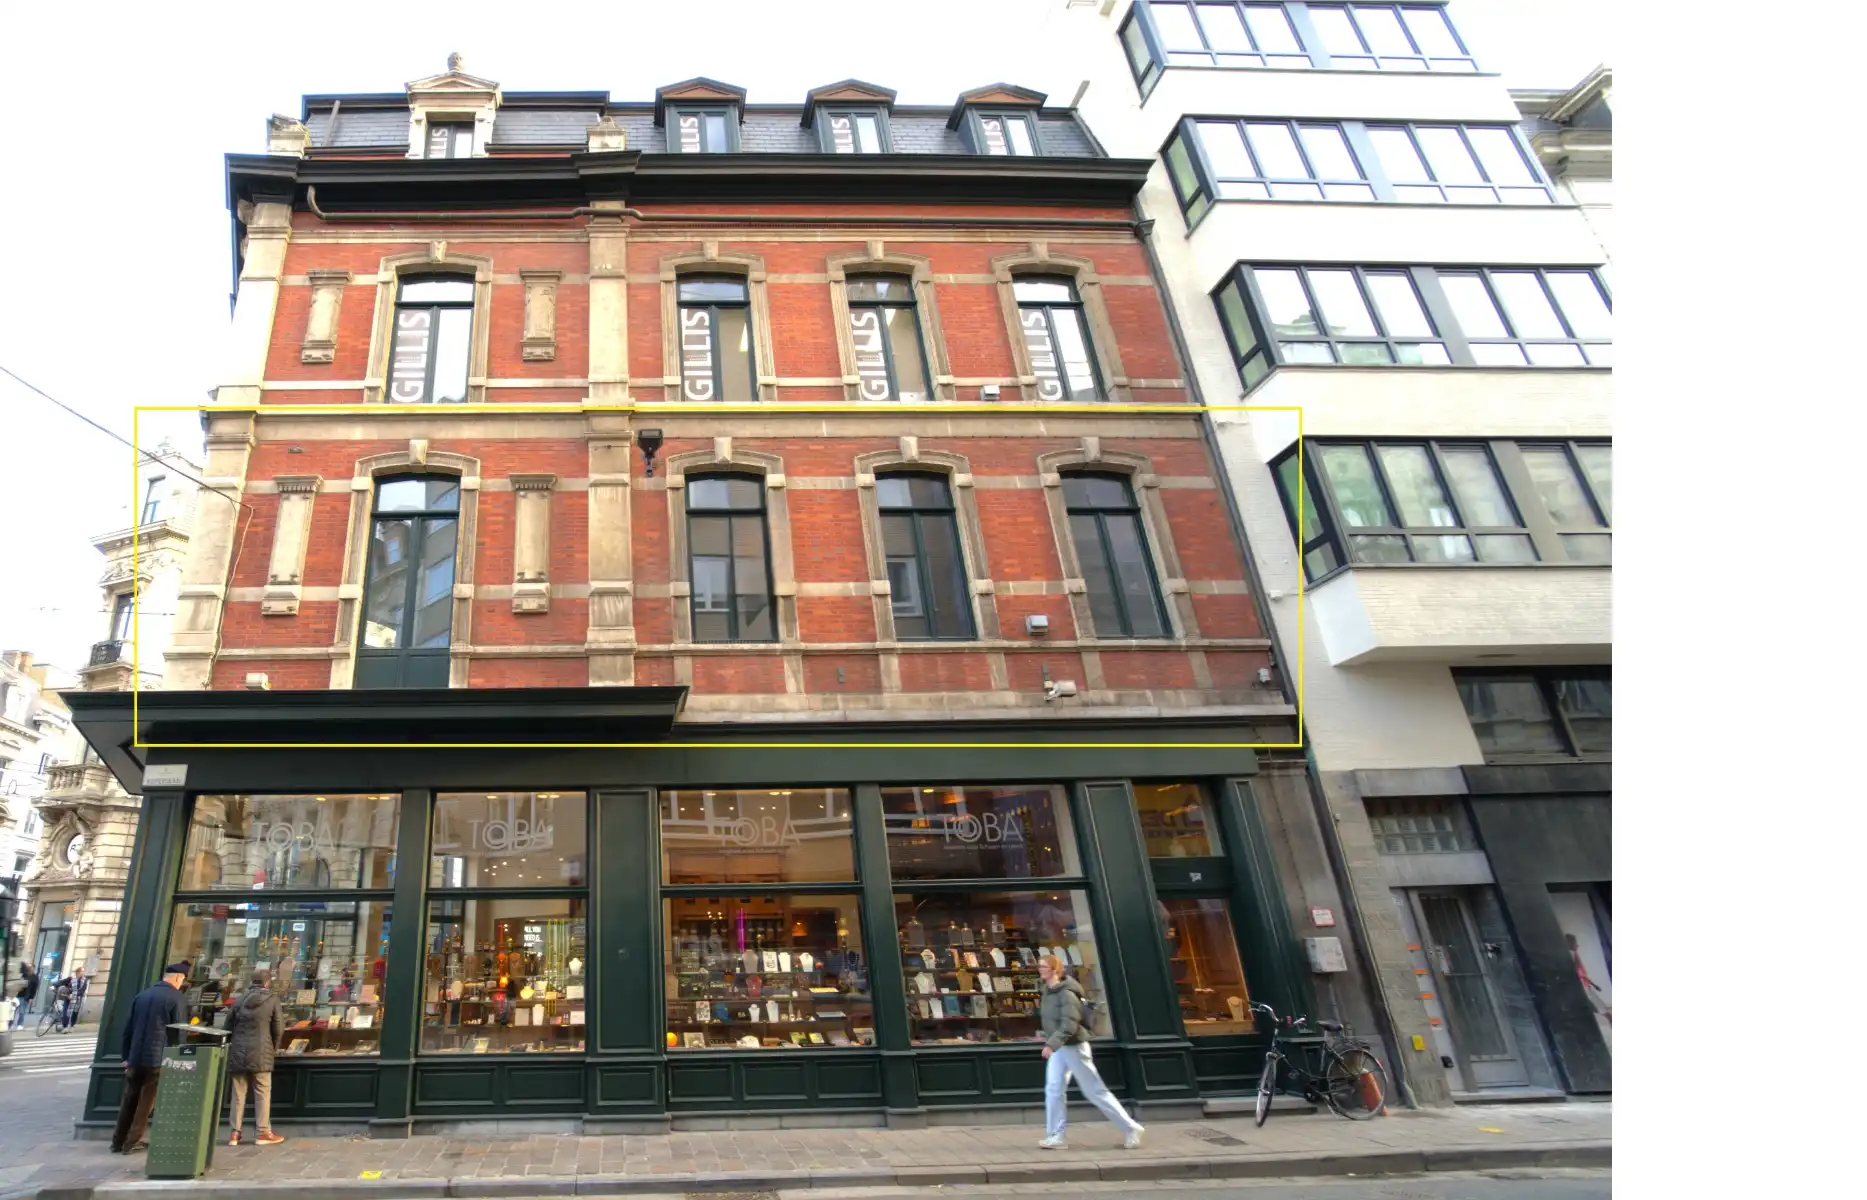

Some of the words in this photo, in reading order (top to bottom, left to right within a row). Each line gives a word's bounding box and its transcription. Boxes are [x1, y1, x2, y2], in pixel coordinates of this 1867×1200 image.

[429, 128, 448, 159] LLIS
[679, 116, 700, 153] LLIS
[831, 117, 854, 153] LLIS
[981, 119, 1007, 155] LLIS
[390, 312, 431, 403] GILLIS
[681, 310, 714, 401] GILLIS
[850, 311, 890, 401] GILLIS
[1019, 311, 1063, 401] GILLIS
[252, 821, 335, 853] TOBA
[467, 819, 552, 851] TOBA
[714, 815, 801, 847] TOBA
[937, 812, 1024, 843] TOBA
